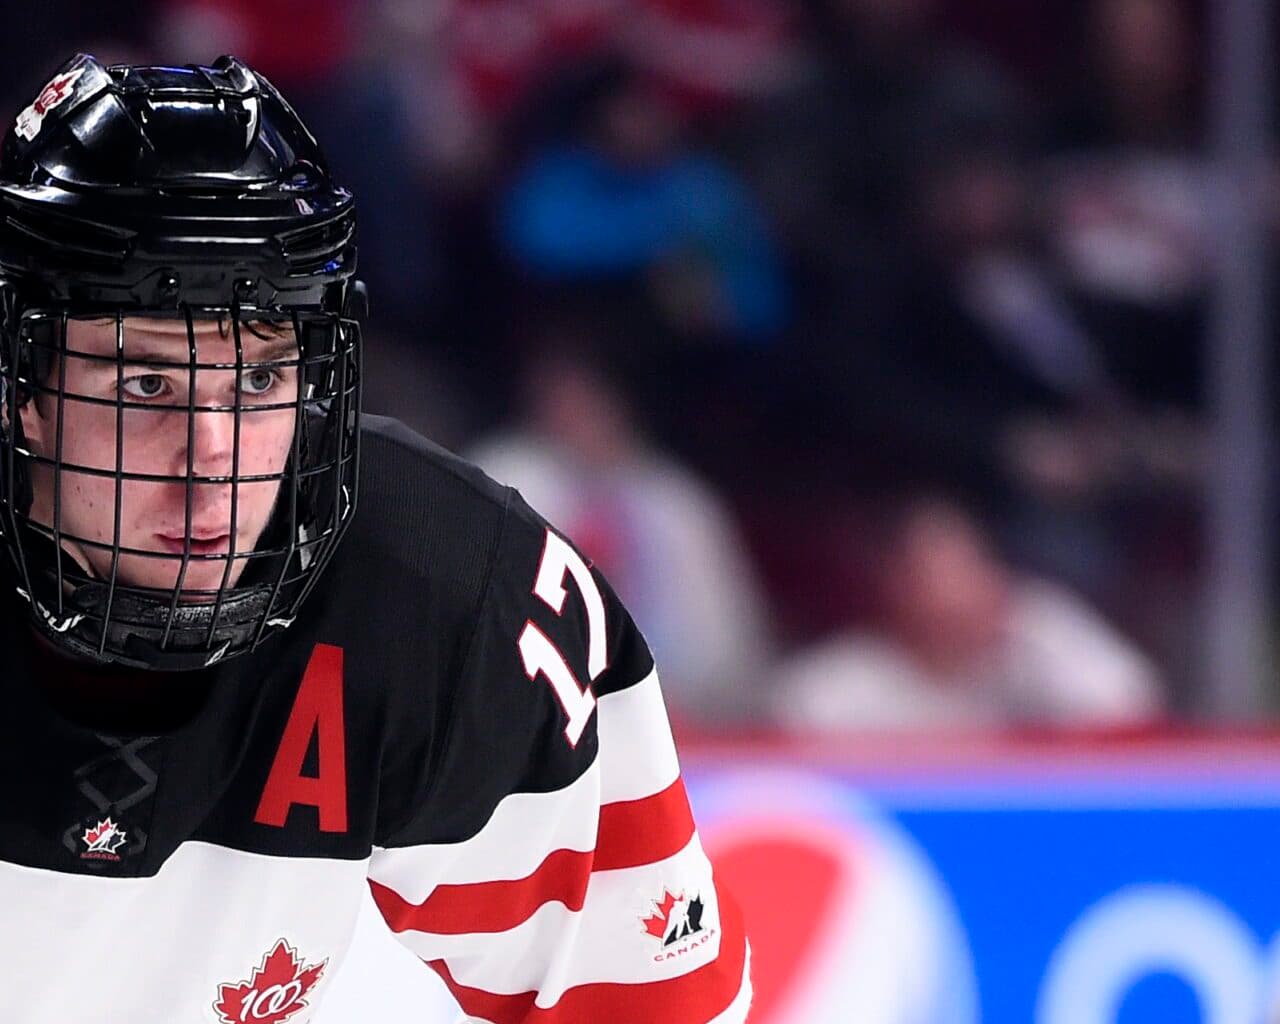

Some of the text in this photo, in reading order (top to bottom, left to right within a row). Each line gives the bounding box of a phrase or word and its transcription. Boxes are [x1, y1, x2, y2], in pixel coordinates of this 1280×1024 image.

[518, 523, 610, 750] 17
[253, 642, 348, 832] A
[240, 979, 302, 1022] 100
[653, 928, 716, 962] CANADA
